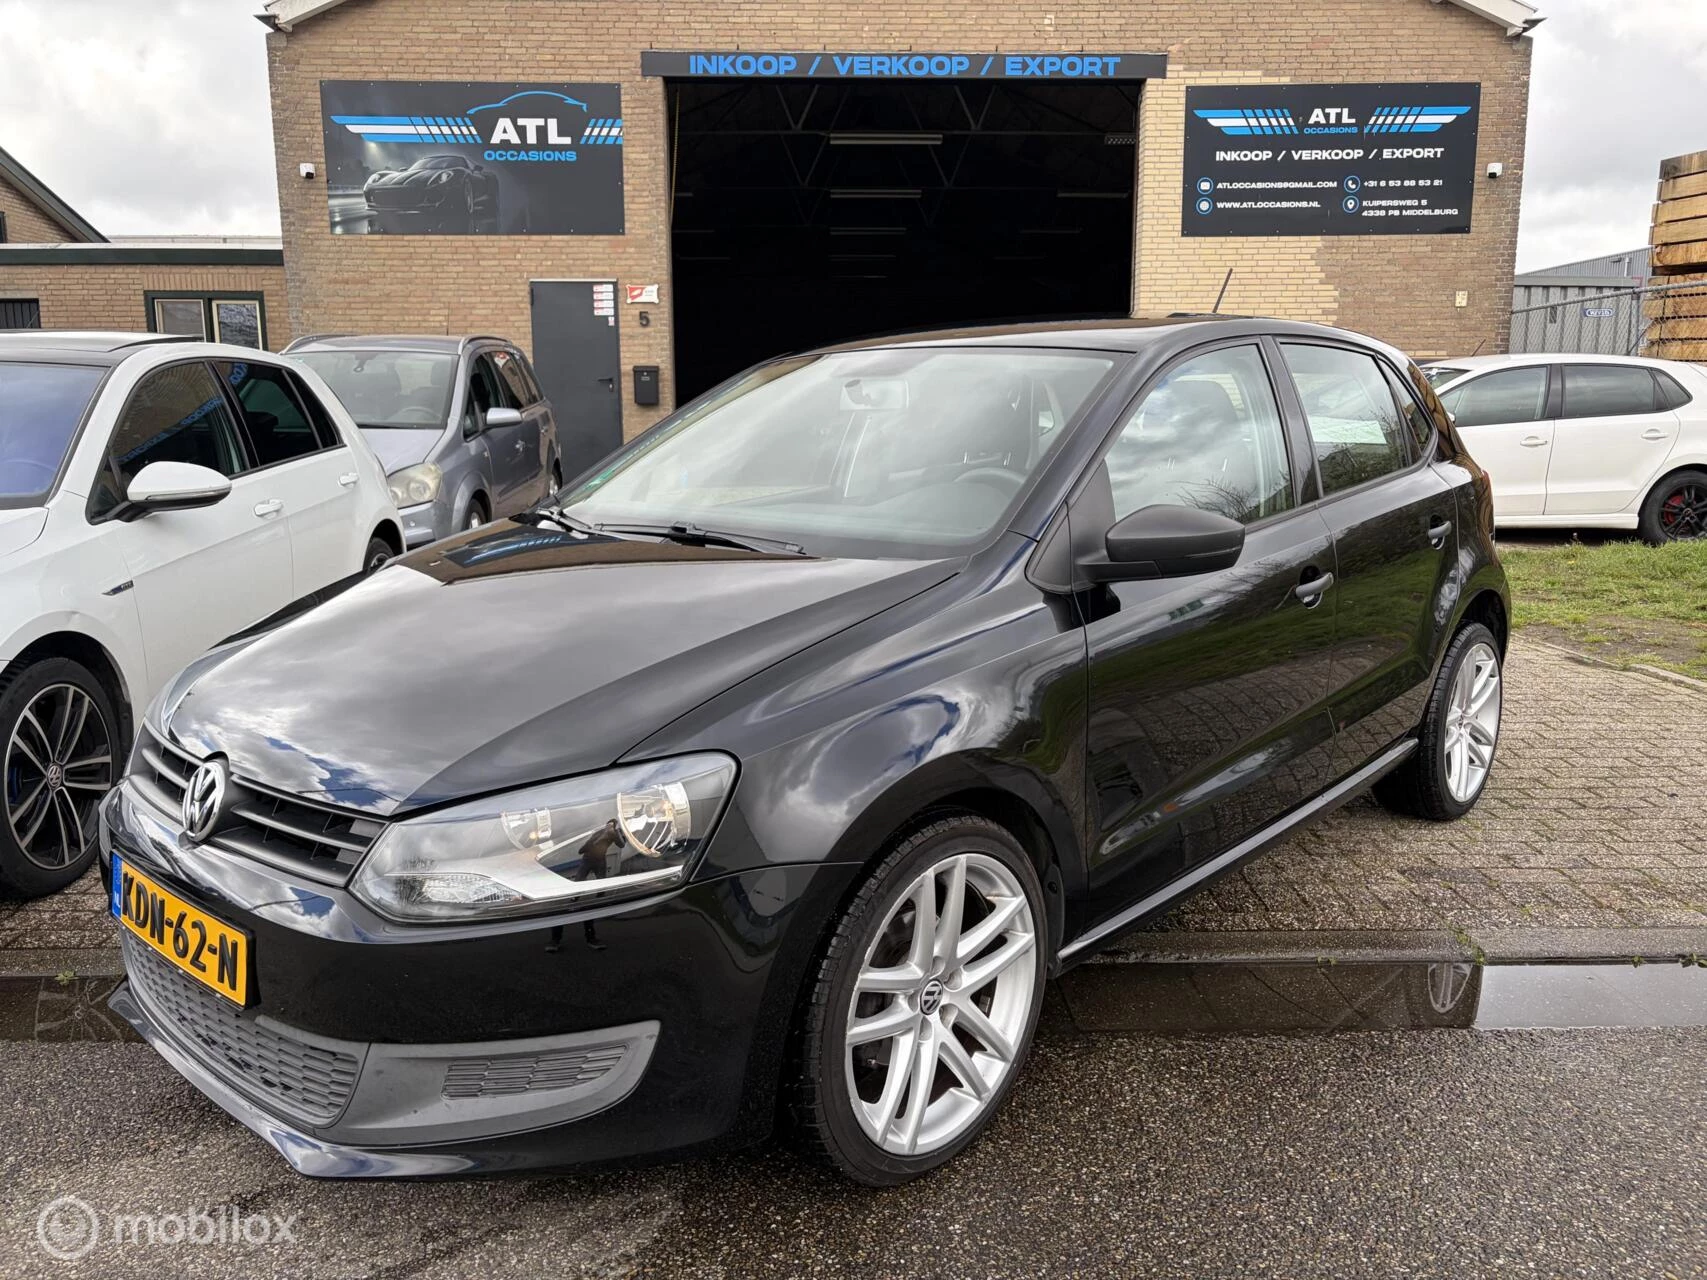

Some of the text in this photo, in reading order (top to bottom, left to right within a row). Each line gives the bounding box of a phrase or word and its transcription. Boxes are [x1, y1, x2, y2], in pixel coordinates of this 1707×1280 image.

[689, 55, 1121, 77] INKOOP / VERKOOP / EXPORT
[1307, 107, 1357, 125] ATL
[489, 117, 573, 145] ATL
[1303, 125, 1359, 135] OCCASIONS
[482, 150, 578, 162] OCCASIONS
[1215, 150, 1273, 162] INKOOP
[1291, 149, 1364, 161] VERKOOP
[1382, 147, 1445, 159] EXPORT
[1418, 179, 1431, 187] 53
[1432, 179, 1443, 187] 21
[1216, 201, 1321, 209] WWW.ATLOCCASIONS.NL
[1362, 199, 1419, 207] KUIPERSWEG
[1402, 208, 1459, 216] MIDDELBURG
[639, 311, 650, 327] 5
[122, 871, 239, 992] KDN-62-N
